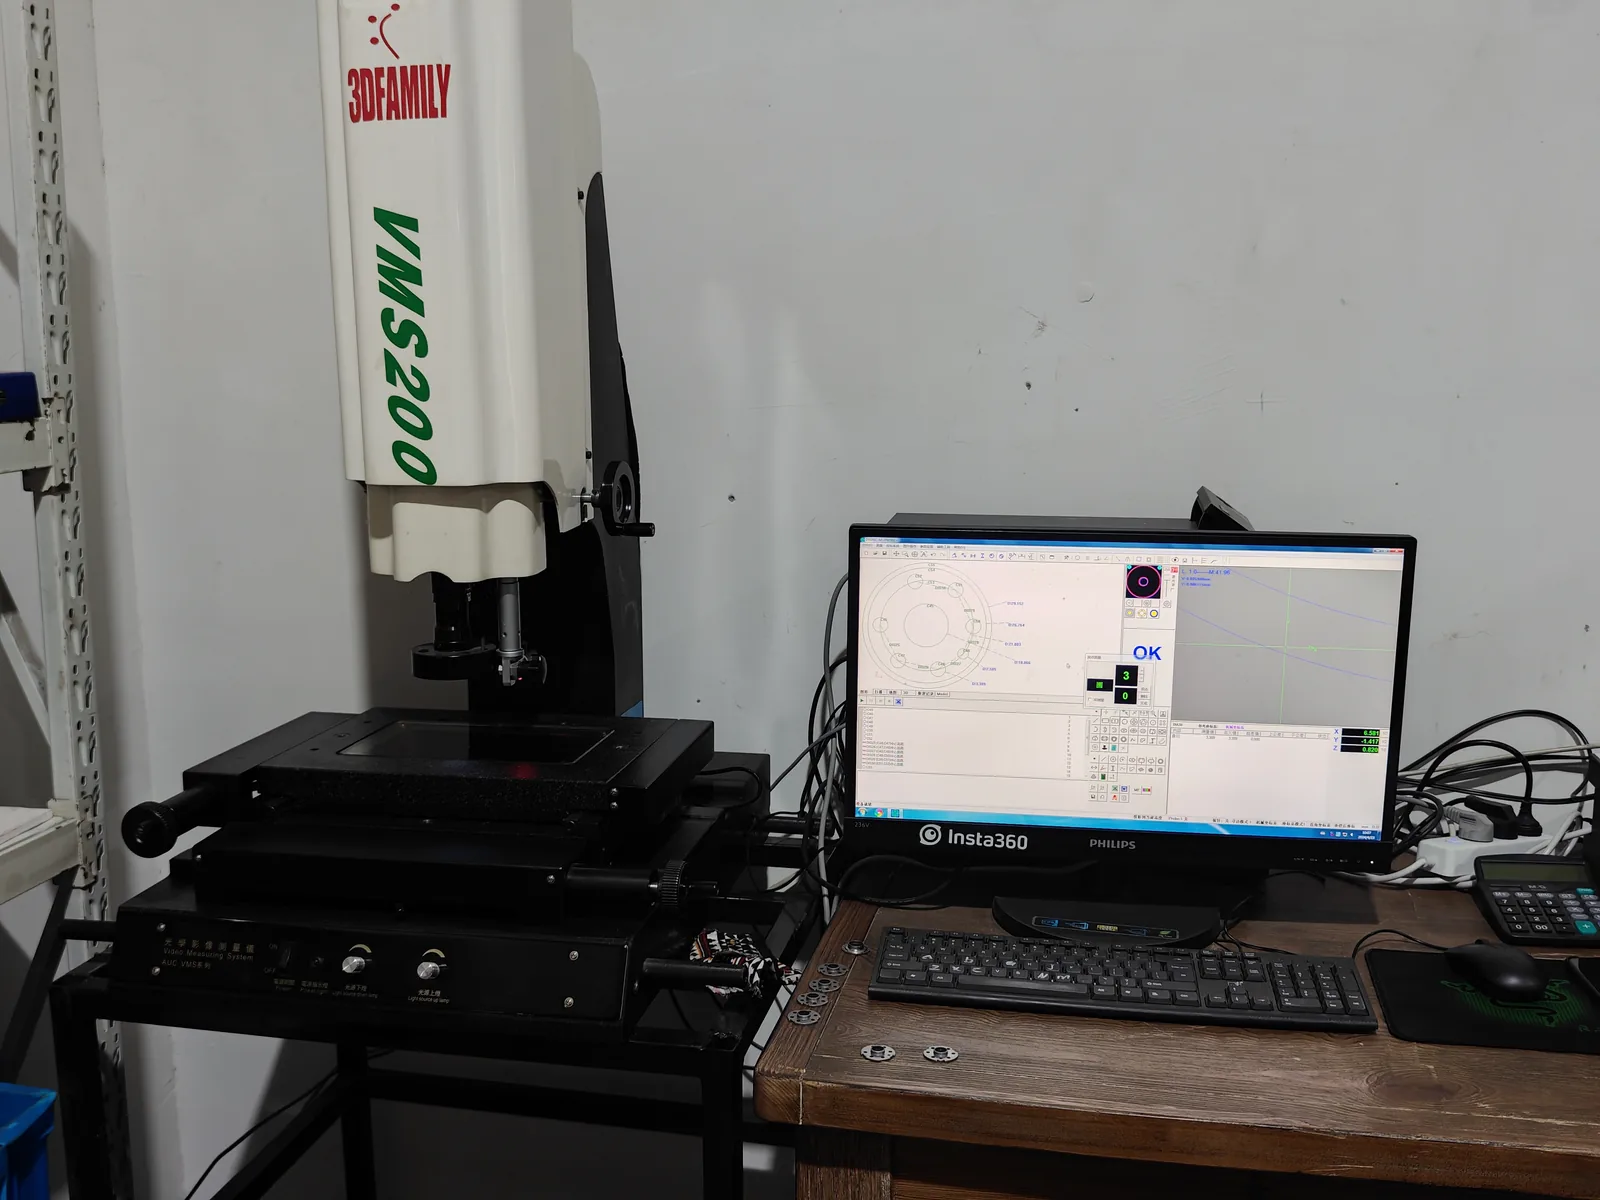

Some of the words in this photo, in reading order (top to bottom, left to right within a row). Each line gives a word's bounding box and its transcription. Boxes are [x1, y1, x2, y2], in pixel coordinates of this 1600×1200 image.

[347, 63, 452, 124] 3DFAMILY
[372, 206, 438, 486] VMS200
[1132, 645, 1162, 661] OK
[1122, 670, 1130, 680] 3
[1122, 692, 1129, 700] 0
[948, 828, 1028, 850] Insta360
[1090, 838, 1136, 850] PHILIPS
[163, 947, 184, 955] Video
[186, 948, 224, 960] Measuring
[226, 953, 254, 962] System
